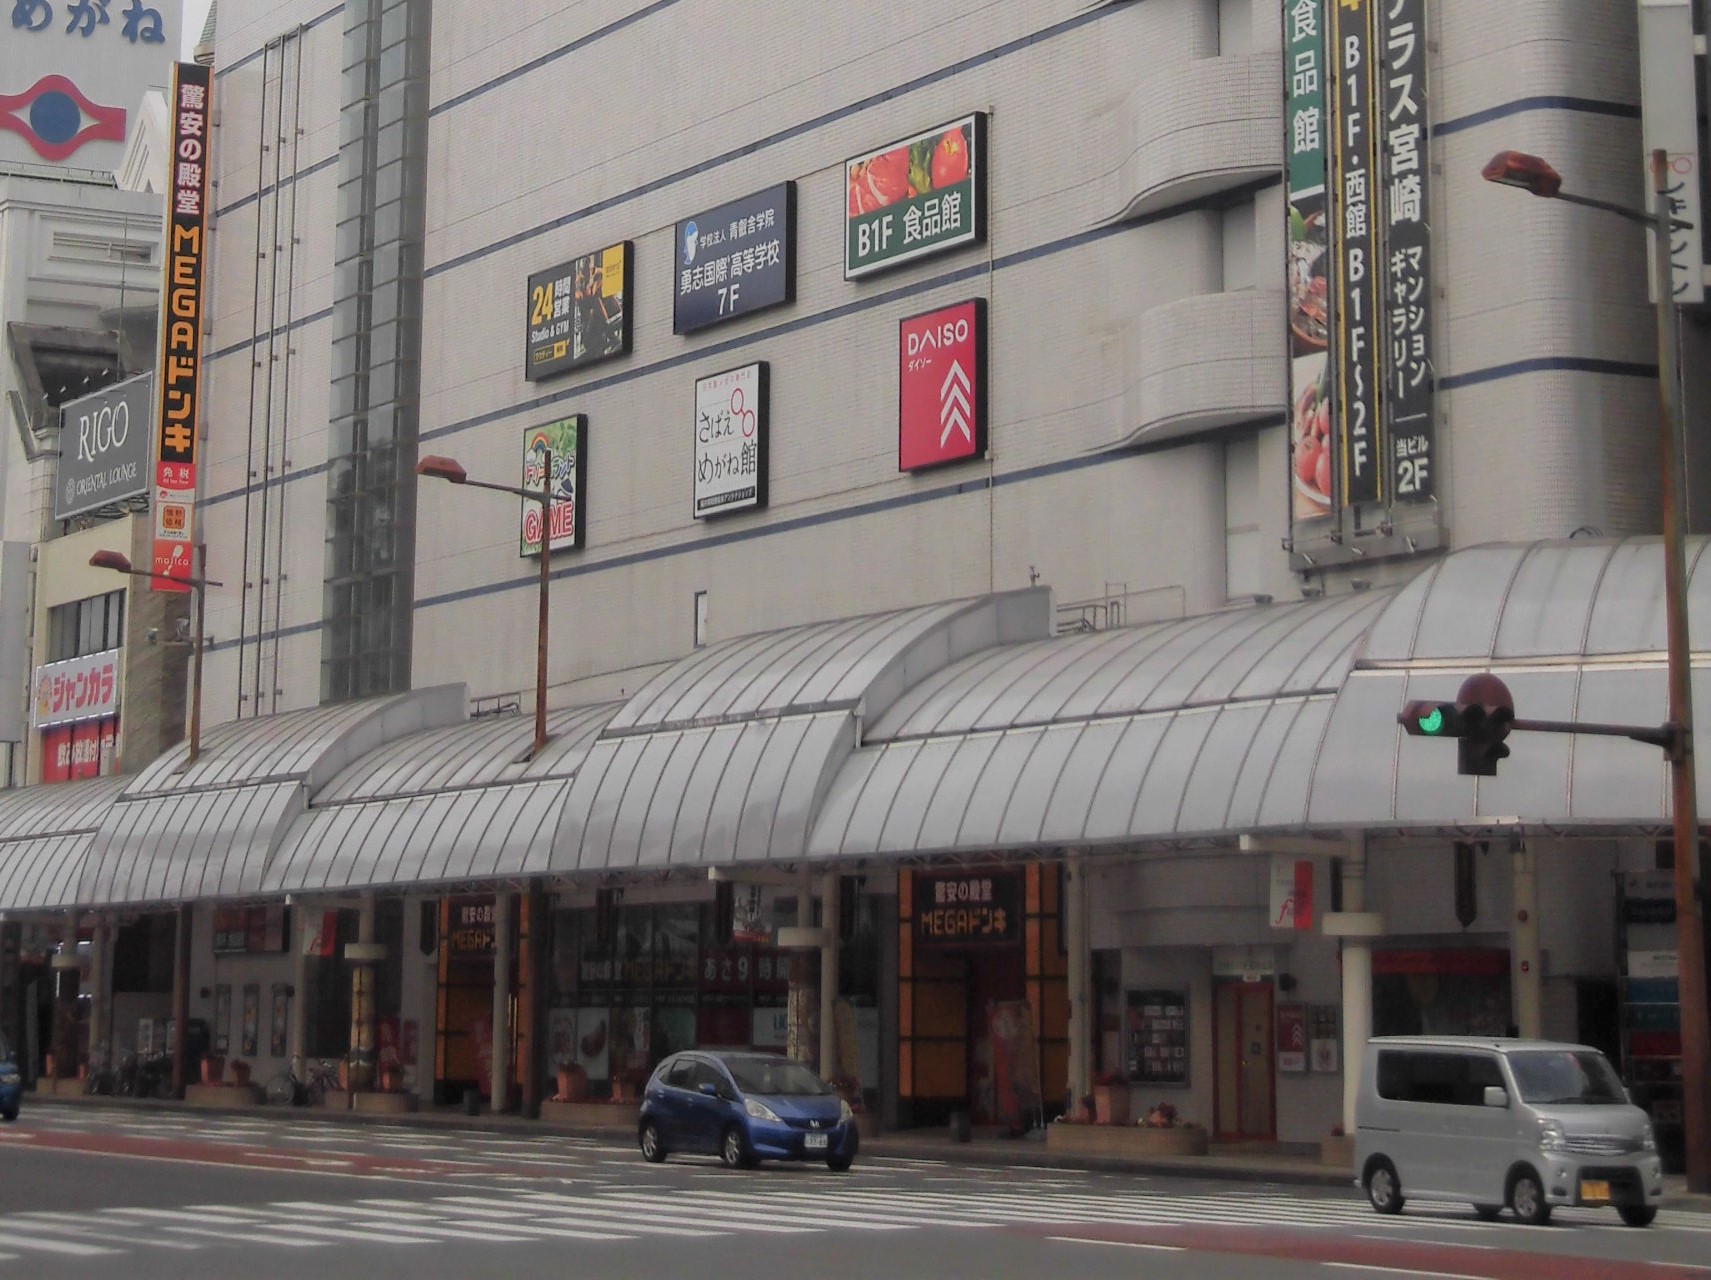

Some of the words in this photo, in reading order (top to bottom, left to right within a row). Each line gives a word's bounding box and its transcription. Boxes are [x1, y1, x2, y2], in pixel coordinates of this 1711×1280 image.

[176, 82, 206, 216] 驚安の殿堂
[700, 229, 727, 250] 学校法人
[857, 214, 893, 258] B1F
[902, 191, 961, 245] 食品館
[531, 282, 554, 326] 24
[717, 283, 740, 316] 7F
[164, 223, 200, 455] MEGAドンキ
[907, 318, 969, 356] DAISO
[908, 358, 932, 372] ダイソー
[77, 400, 130, 462] RIGO
[699, 410, 734, 443] さばえ
[76, 470, 107, 497] ORIENTAL
[109, 462, 138, 485] LOUNGE
[698, 438, 757, 485] めがね館
[1397, 461, 1429, 494] 2F
[53, 663, 114, 713] ジャンカラ
[920, 906, 1007, 936] MEGAドンキ
